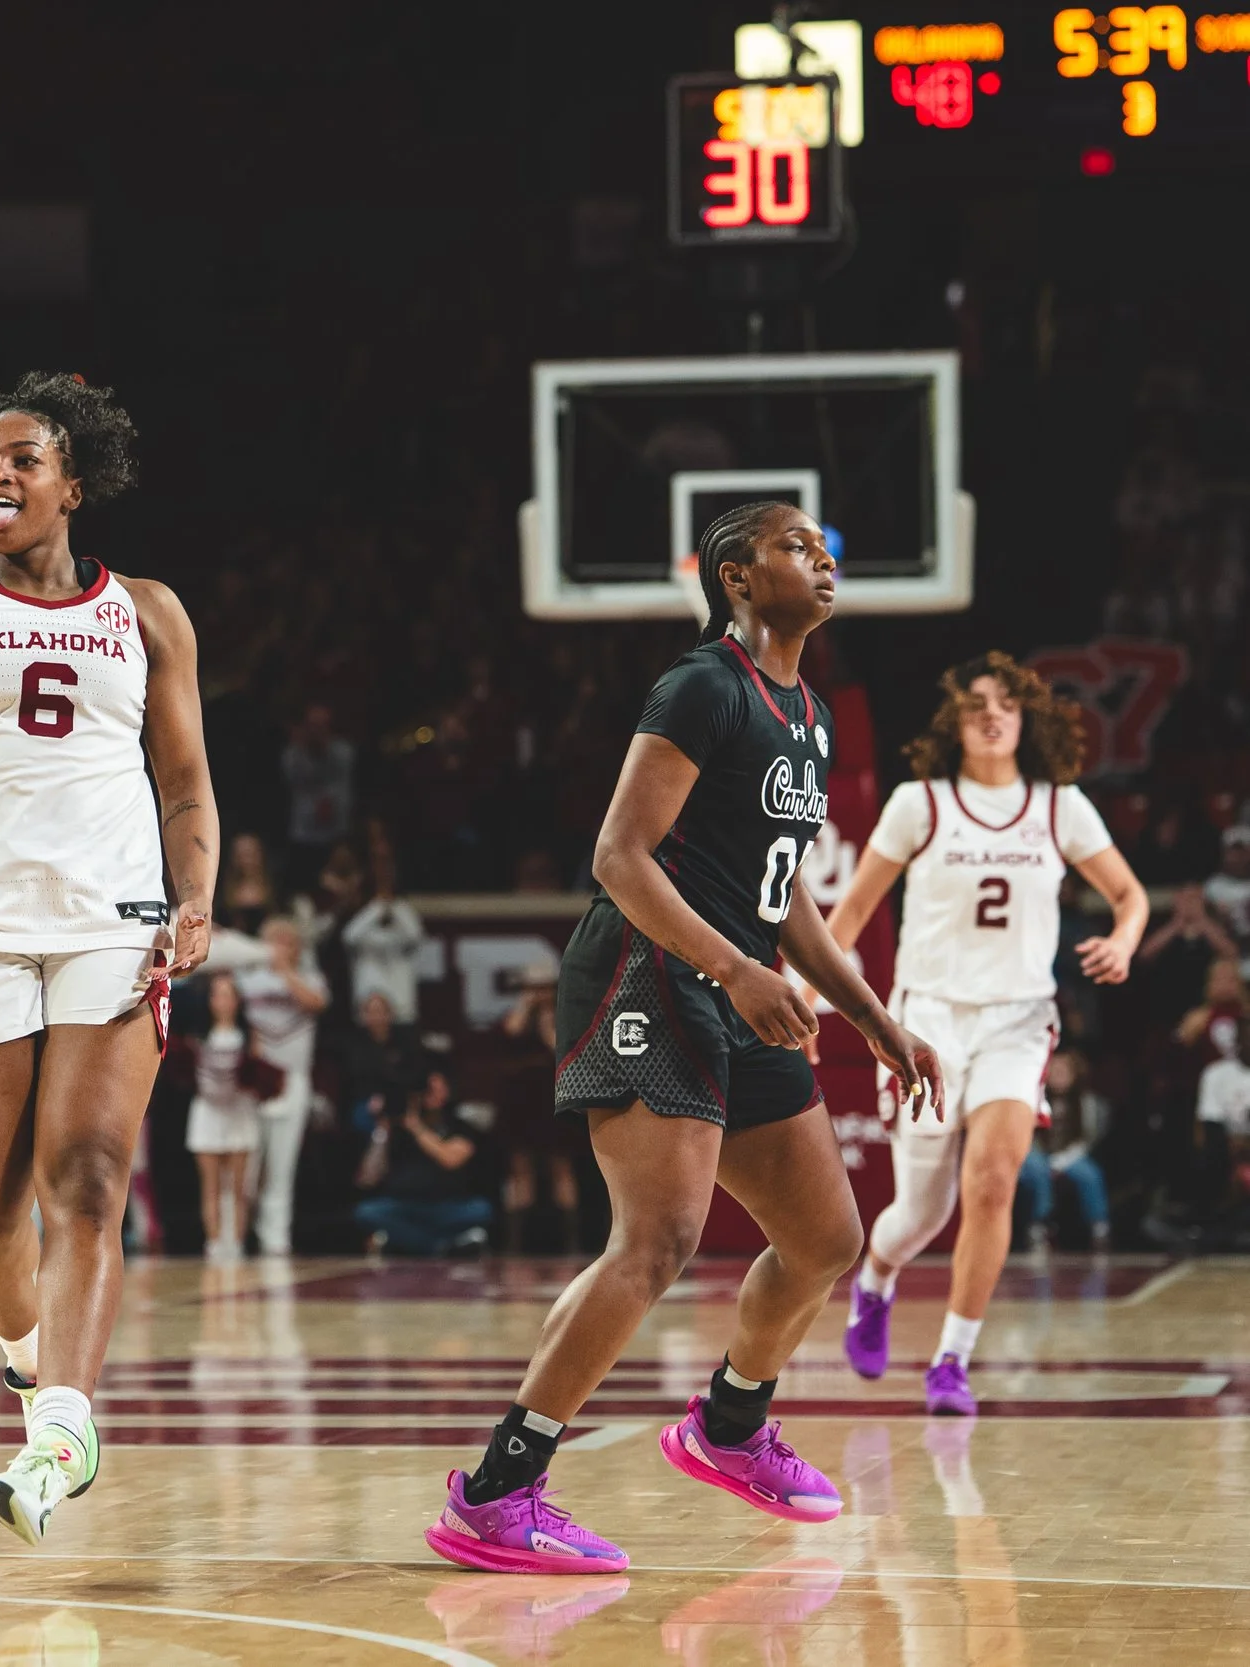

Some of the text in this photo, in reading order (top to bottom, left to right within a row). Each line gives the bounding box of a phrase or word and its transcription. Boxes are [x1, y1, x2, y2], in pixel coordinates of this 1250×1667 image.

[1054, 5, 1187, 78] 5:39
[703, 140, 809, 227] 30
[97, 602, 130, 633] SEC
[18, 661, 78, 739] 6
[944, 850, 1043, 867] OKLAHOMA
[975, 877, 1010, 929] 2
